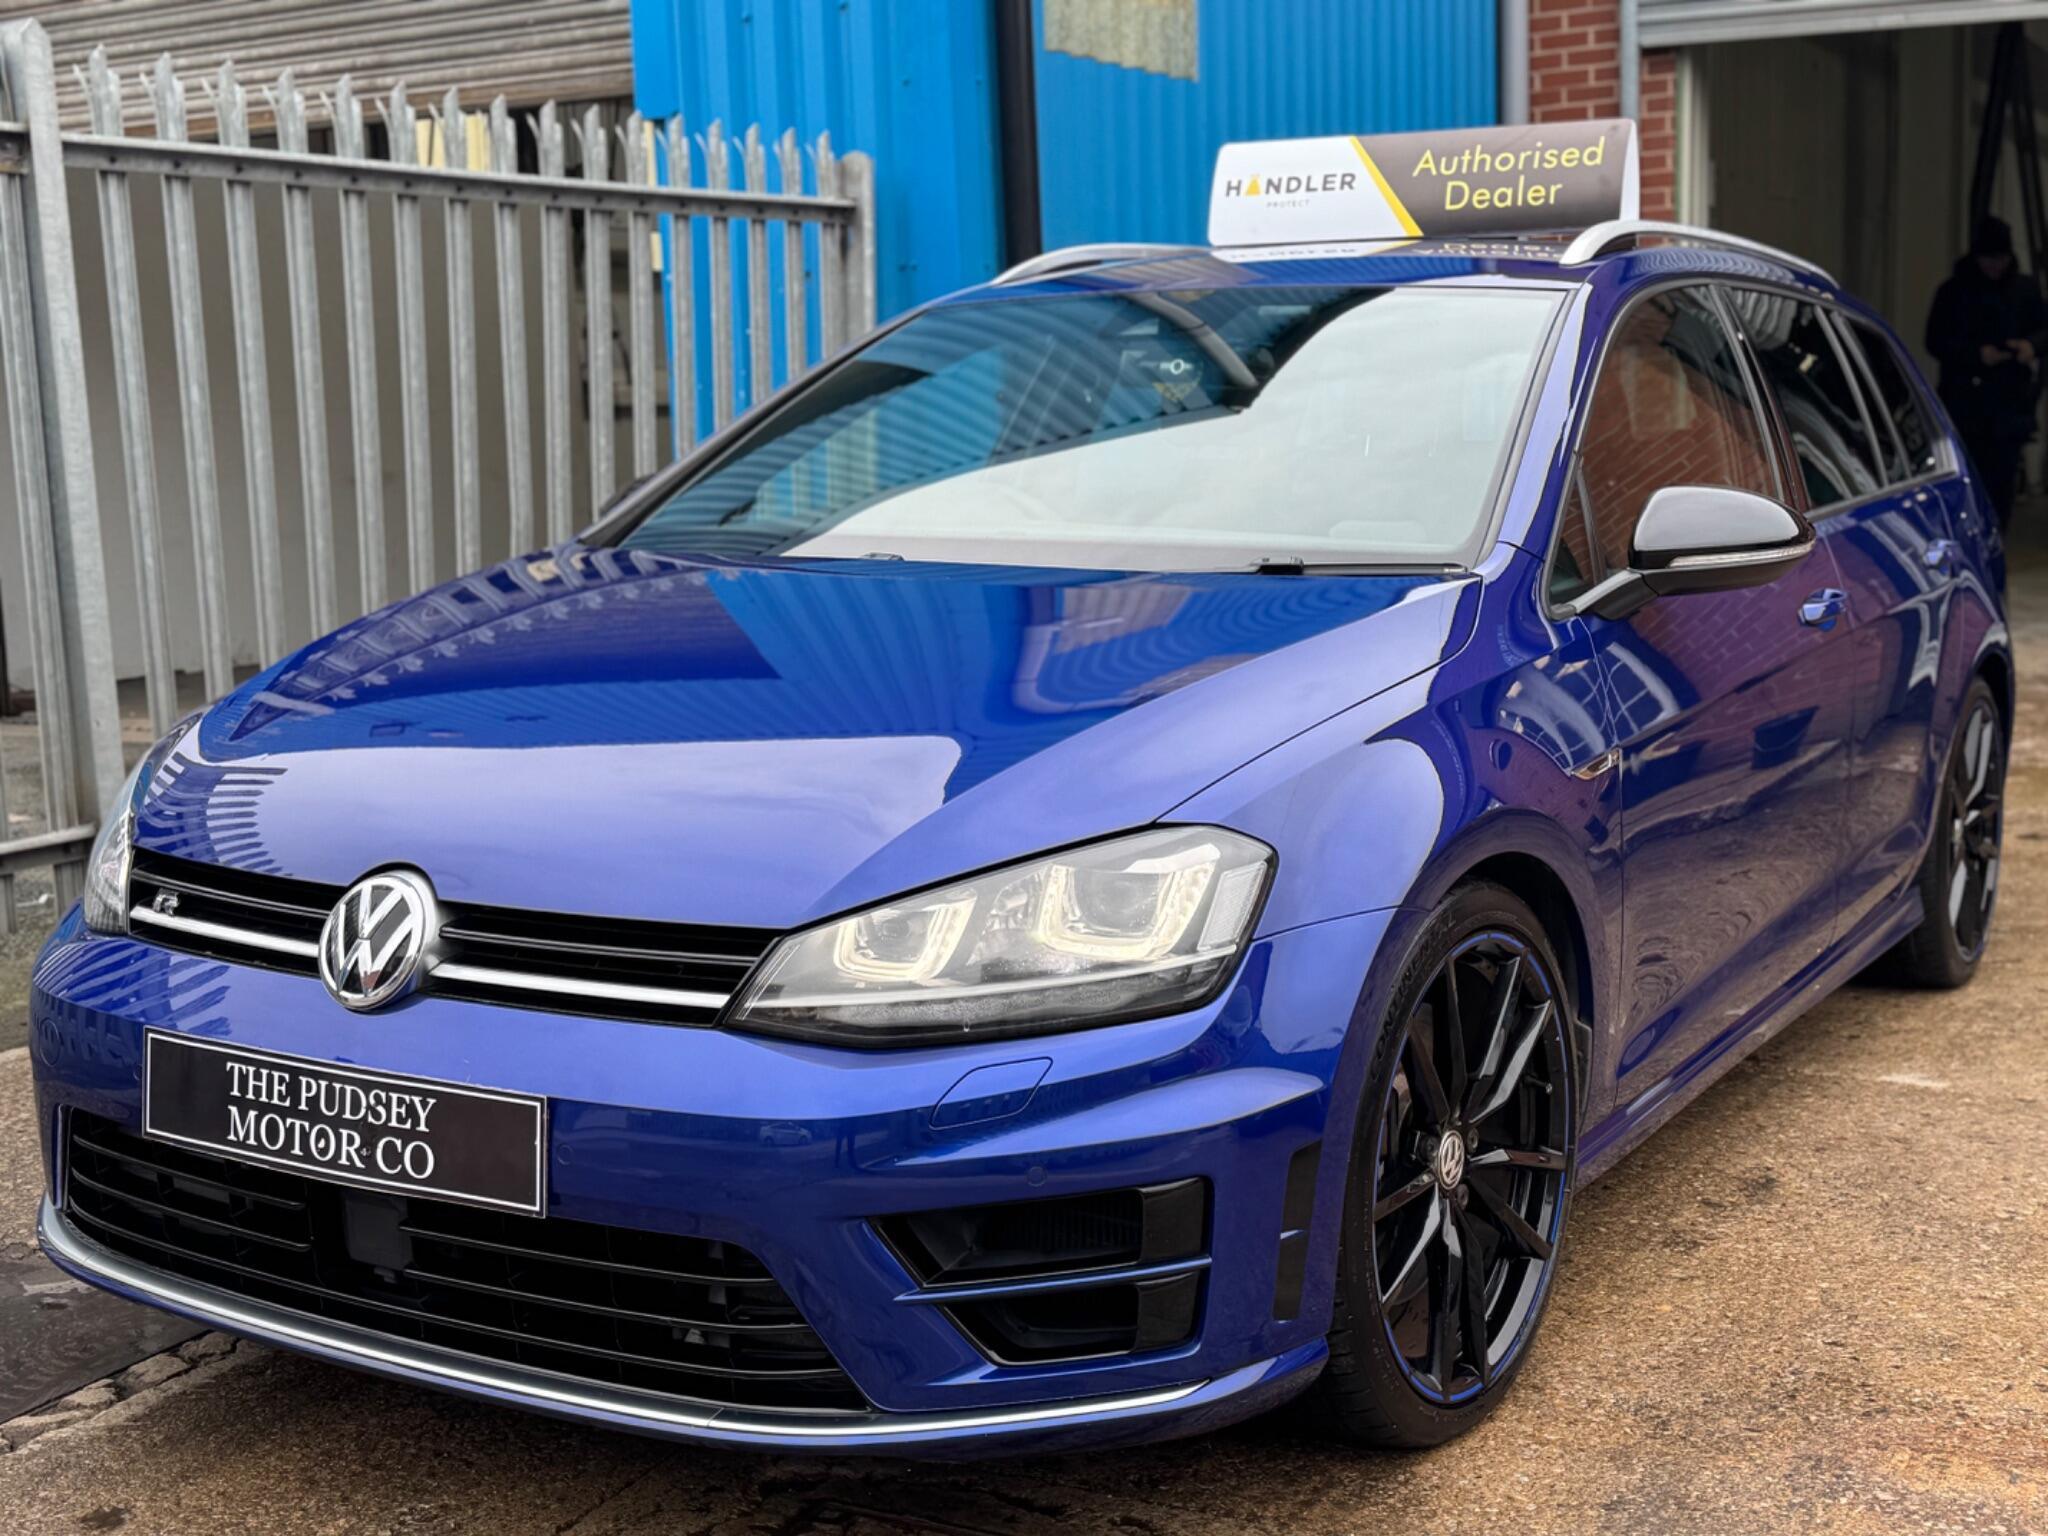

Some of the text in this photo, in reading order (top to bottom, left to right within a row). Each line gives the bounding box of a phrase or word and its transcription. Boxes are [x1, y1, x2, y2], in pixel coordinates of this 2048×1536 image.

[1412, 136, 1606, 177] Authorised
[1444, 176, 1562, 211] Dealer
[226, 1062, 436, 1132] THE PUDSEY
[227, 1106, 435, 1180] MOTOR CO
